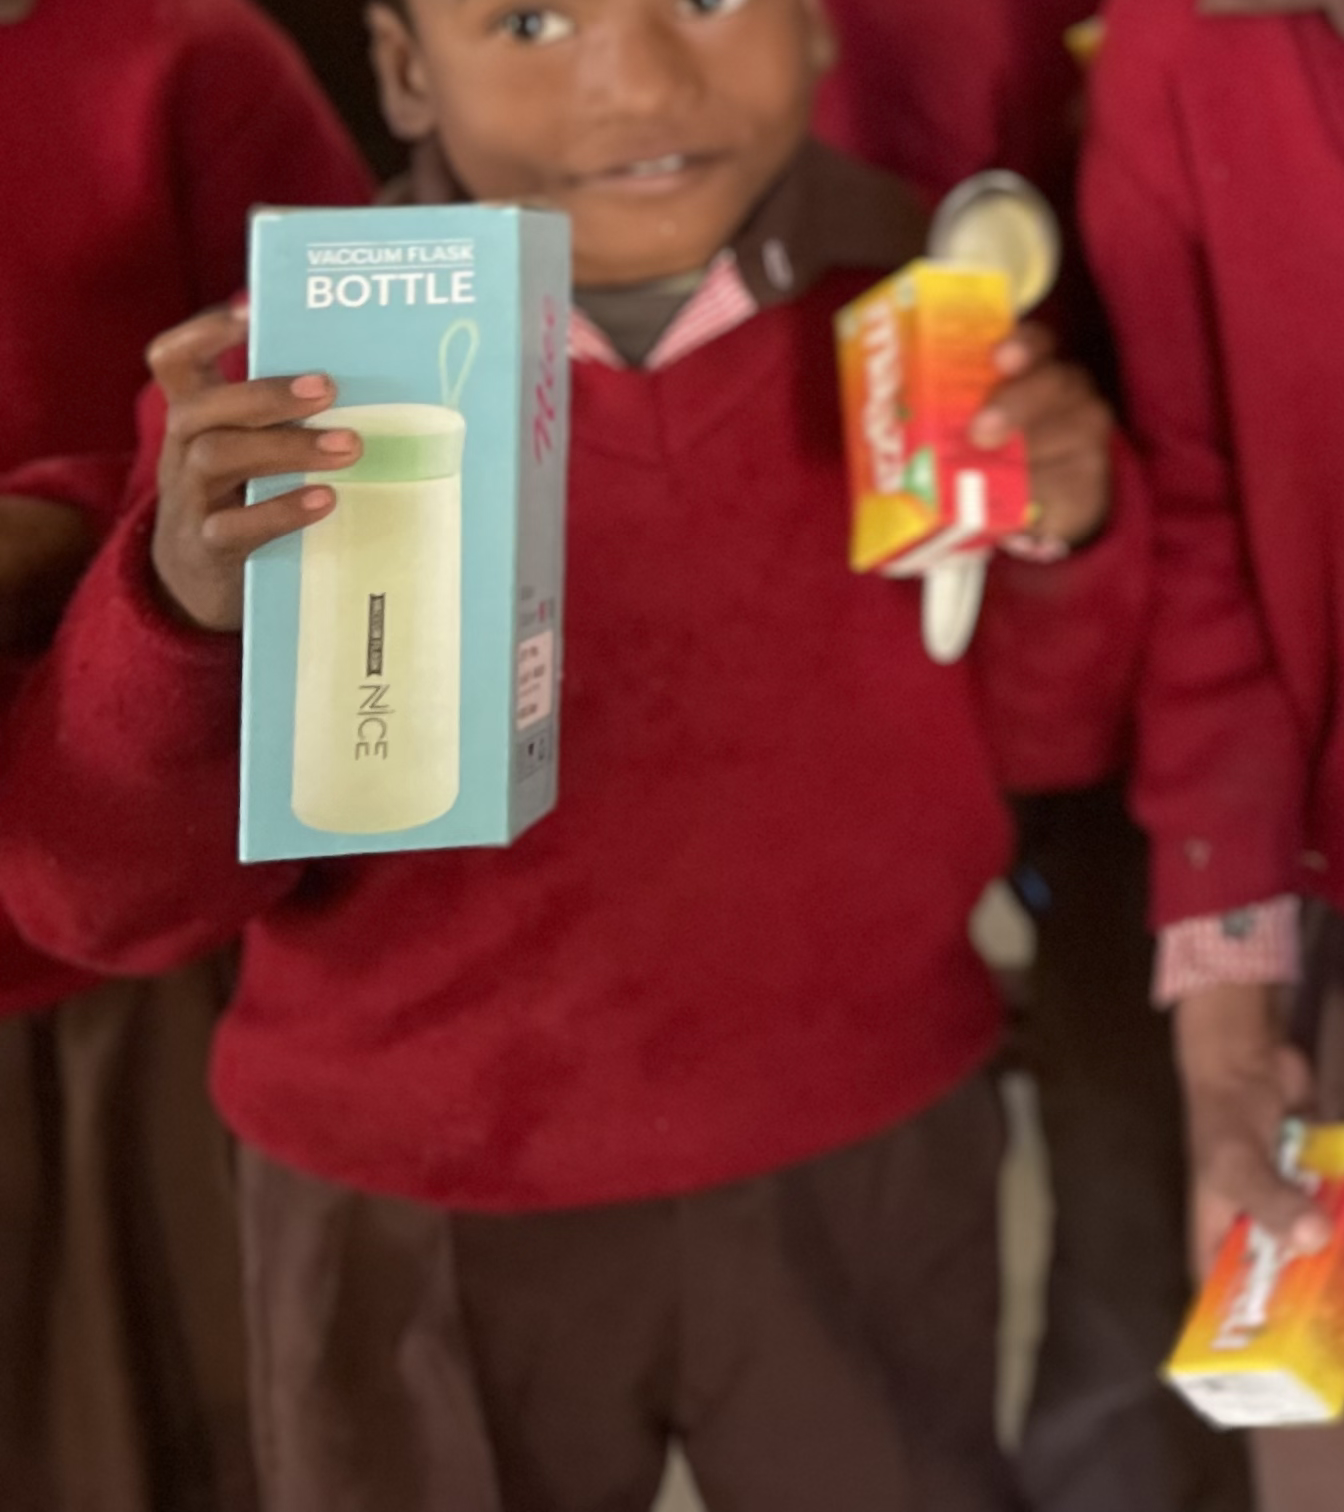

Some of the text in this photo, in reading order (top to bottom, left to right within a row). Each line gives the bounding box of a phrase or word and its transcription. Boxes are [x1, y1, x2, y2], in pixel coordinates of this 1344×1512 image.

[306, 244, 475, 266] VACCUM FLASK
[306, 270, 476, 309] BOTTLE
